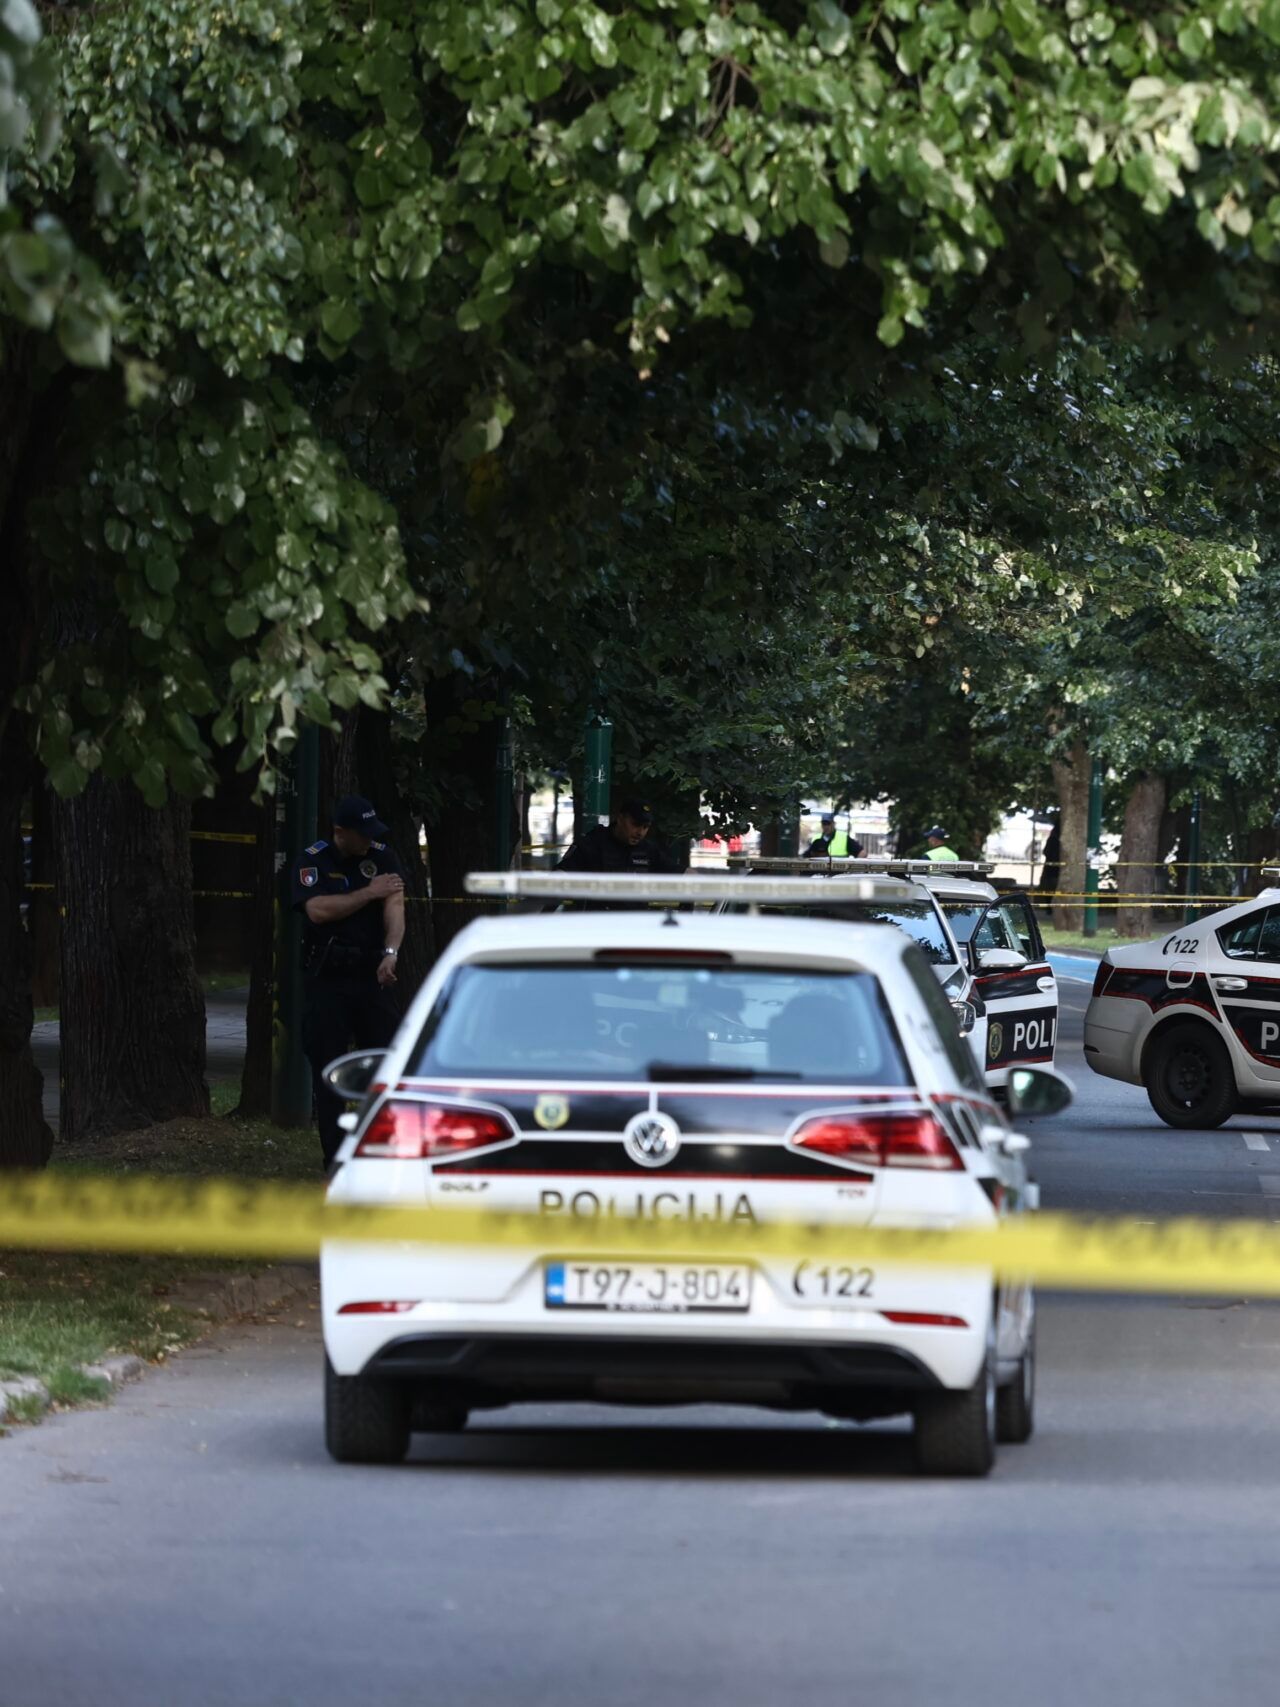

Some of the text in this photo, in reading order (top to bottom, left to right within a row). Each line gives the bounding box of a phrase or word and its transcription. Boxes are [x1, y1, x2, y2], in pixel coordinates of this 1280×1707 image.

[1174, 939, 1199, 953] 122
[1013, 1018, 1056, 1052] POLI
[573, 1267, 740, 1300] T97-J-804
[820, 1267, 875, 1297] 122
